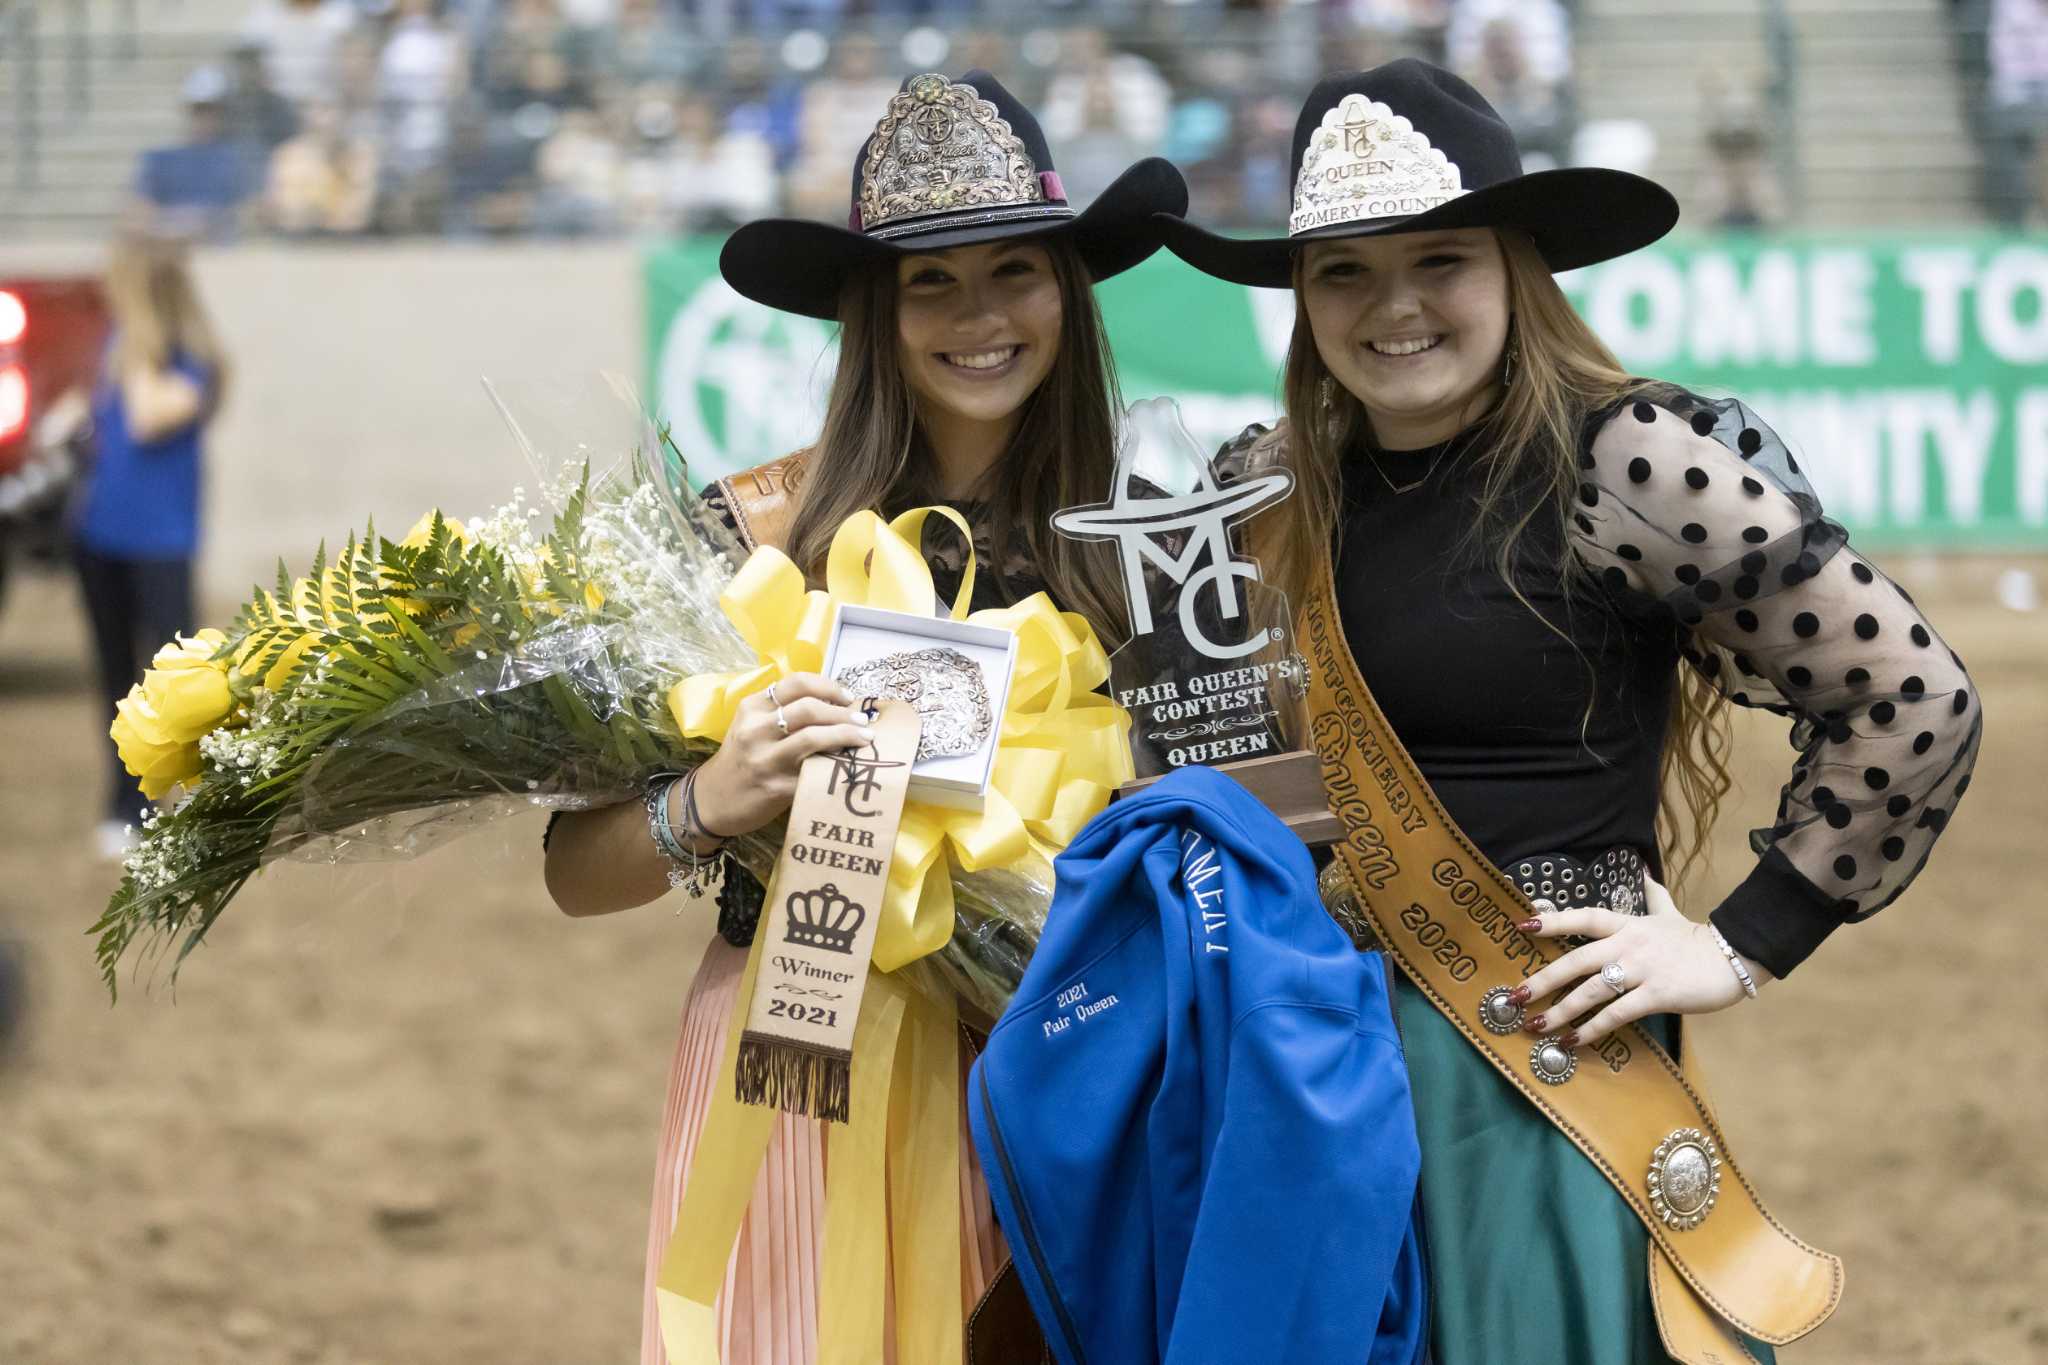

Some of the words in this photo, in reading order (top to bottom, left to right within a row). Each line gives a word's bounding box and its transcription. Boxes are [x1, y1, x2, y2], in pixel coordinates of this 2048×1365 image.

[1326, 159, 1395, 184] QUEEN
[1119, 681, 1181, 708] FAIR
[1188, 660, 1292, 695] QUEEN'S
[1152, 686, 1266, 723] CONTEST
[1167, 732, 1269, 767] QUEEN
[807, 819, 875, 849] FAIR
[790, 843, 884, 877] QUEEN
[1400, 903, 1477, 982] 2020
[772, 956, 854, 984] Winner
[1056, 982, 1088, 1008] 2021
[768, 998, 837, 1028] 2021
[1042, 1016, 1071, 1038] Fair
[1075, 994, 1119, 1023] Queen
